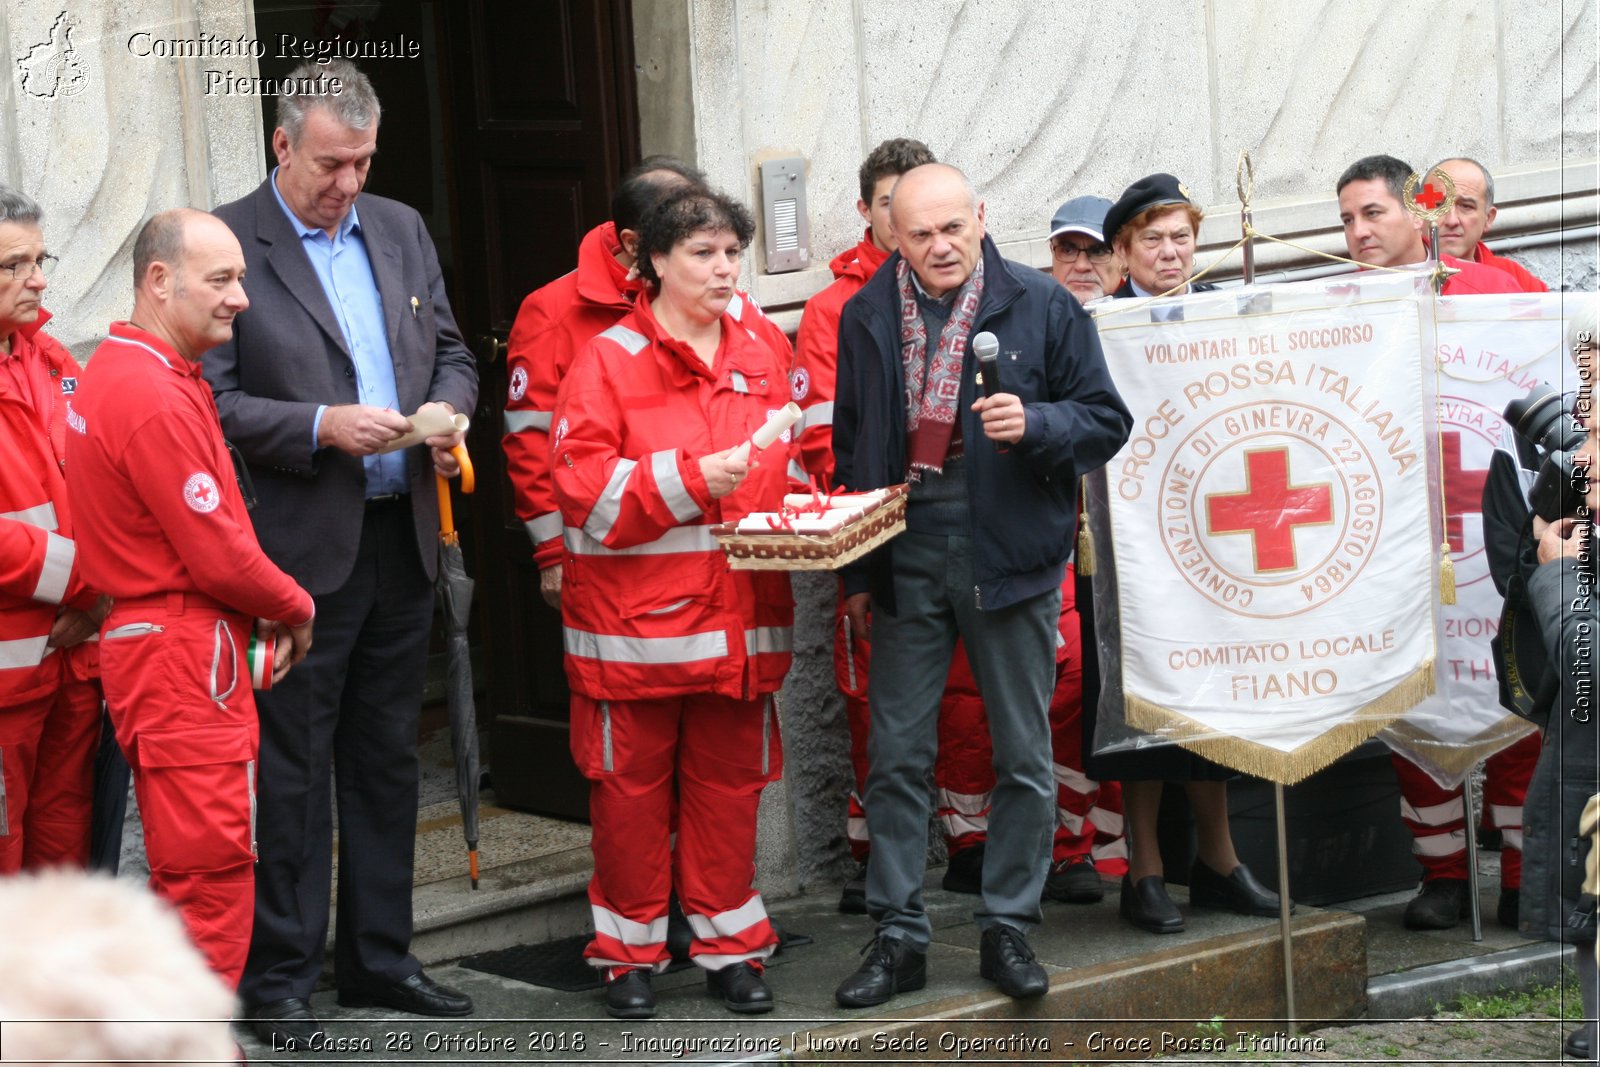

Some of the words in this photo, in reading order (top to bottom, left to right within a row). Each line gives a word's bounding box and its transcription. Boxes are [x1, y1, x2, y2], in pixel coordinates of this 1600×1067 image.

[1144, 337, 1237, 364] VOLONTARI
[1248, 334, 1280, 356] DEL
[1287, 323, 1374, 351] SOCCORSO
[1117, 399, 1185, 500] CROCE
[1183, 360, 1297, 409] ROSSA
[1304, 363, 1418, 476] ITALIANA
[1191, 431, 1219, 457] DI
[1224, 406, 1330, 441] GINEVRA
[1332, 438, 1362, 469] 22
[1165, 463, 1254, 607] CONVENZIONE
[1344, 473, 1377, 557] AGOSTO
[1300, 559, 1352, 602] 1864
[1168, 642, 1290, 671] COMITATO
[1299, 629, 1396, 660] LOCALE
[1230, 668, 1338, 701] FIANO
